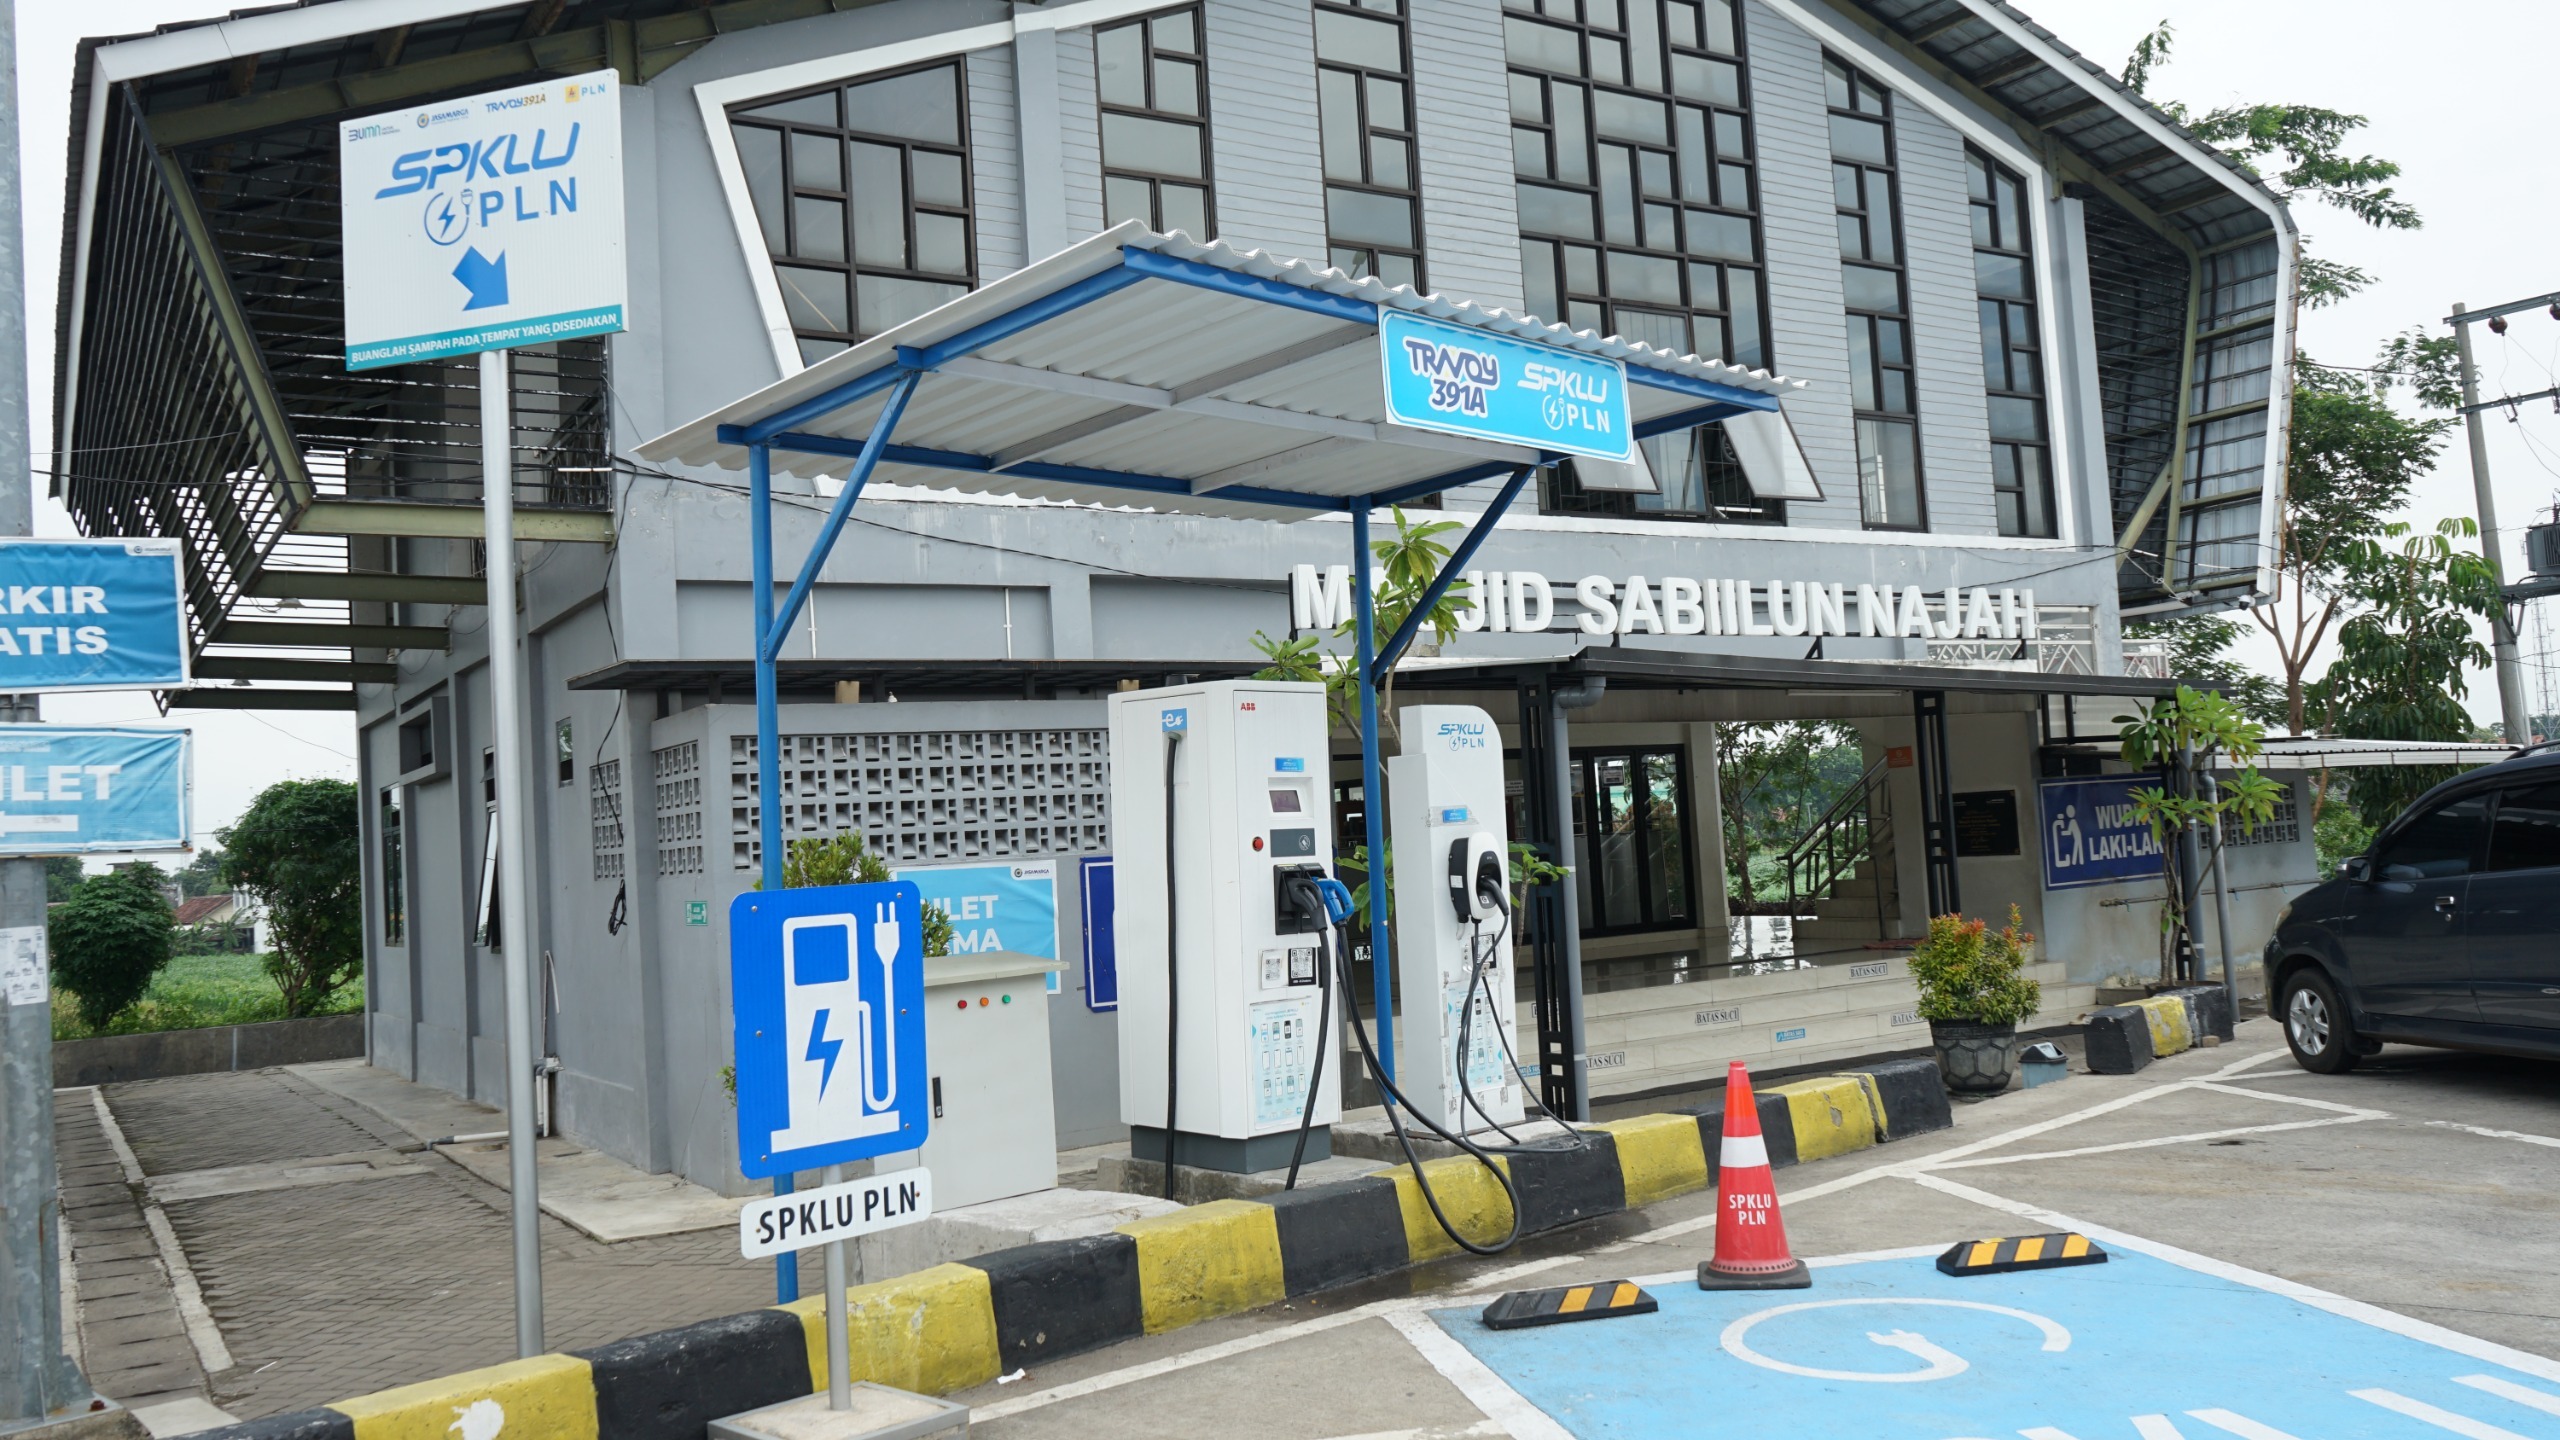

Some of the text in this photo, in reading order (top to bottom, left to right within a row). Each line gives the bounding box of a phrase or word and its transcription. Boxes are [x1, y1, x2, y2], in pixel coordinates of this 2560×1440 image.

[581, 84, 606, 96] PLN
[375, 122, 580, 199] SPKLU
[480, 177, 577, 227] PLN
[352, 313, 617, 363] BUANGLAH SAMPAH PADA TEMPAT YANG DISEDIAKAN
[1517, 362, 1608, 403] SPKLU
[1431, 380, 1486, 414] 391A
[1568, 406, 1611, 433] PLN
[0, 586, 109, 614] KIR
[1292, 564, 2036, 641] MJID SABIILUN NAJAH
[1240, 702, 1256, 711] ABB
[1437, 723, 1484, 735] SPKLU
[1462, 738, 1485, 748] PLN
[0, 765, 121, 800] LET
[2088, 832, 2165, 862] LAKI-LAK
[1850, 965, 1886, 978] BATAS SUCI
[1696, 1009, 1738, 1024] BATAS SUCI
[1892, 1013, 1913, 1025] BATAS
[1585, 1054, 1623, 1068] TAS SUCI
[760, 1180, 917, 1245] SPKLU PLN
[1729, 1193, 1772, 1209] SPKLU
[1738, 1210, 1766, 1225] PLN
